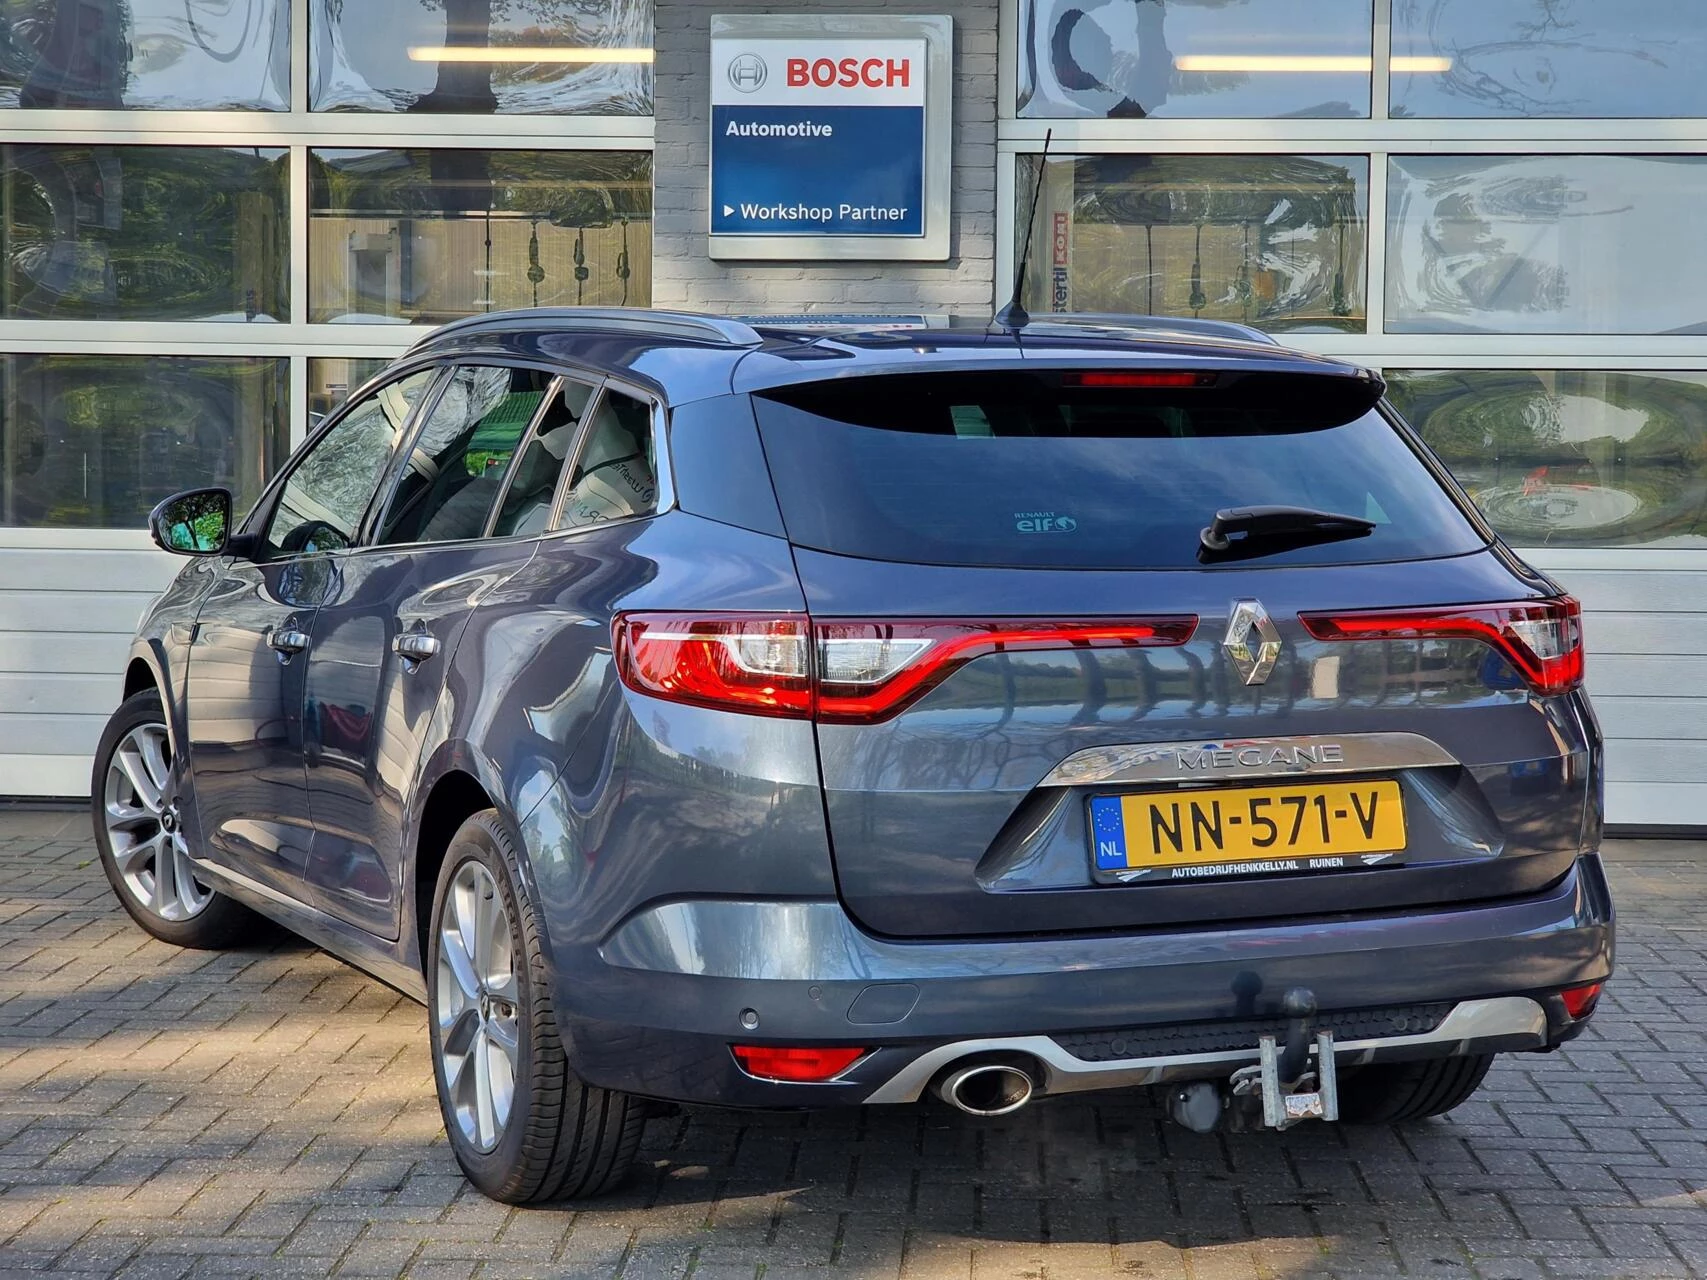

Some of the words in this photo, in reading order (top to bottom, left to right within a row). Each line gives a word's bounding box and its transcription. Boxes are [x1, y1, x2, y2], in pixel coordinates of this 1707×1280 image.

[787, 58, 910, 87] BOSCH
[726, 121, 833, 137] Automotive
[740, 203, 833, 223] Workshop
[839, 204, 908, 220] Partner
[1017, 519, 1053, 532] elf
[1176, 744, 1344, 770] MEGANE
[1100, 841, 1122, 857] NL
[1149, 791, 1378, 854] NN-571-V
[1171, 860, 1299, 878] AUTOBEDRIJFHENKKELLY.NL
[1309, 857, 1344, 868] RUINEN
